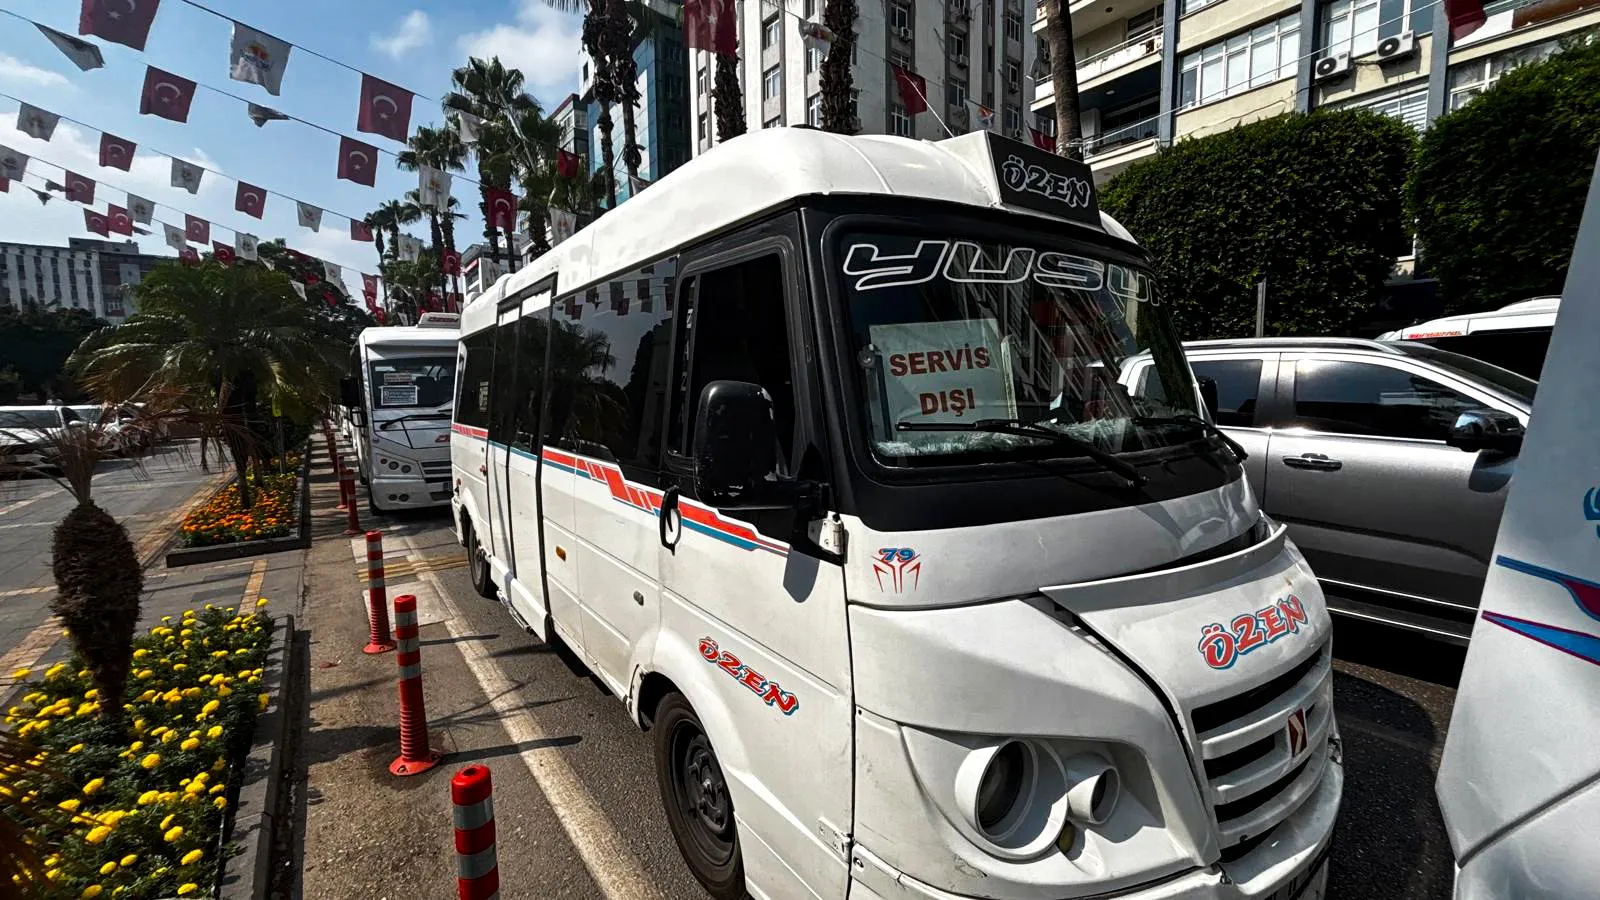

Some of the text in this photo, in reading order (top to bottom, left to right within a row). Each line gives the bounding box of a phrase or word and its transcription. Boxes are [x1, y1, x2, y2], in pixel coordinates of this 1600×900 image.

[1002, 154, 1091, 208] ÖZEN
[889, 343, 991, 377] SERVİS
[919, 387, 975, 417] DIŞI
[879, 547, 915, 563] 79
[1198, 594, 1309, 669] ÖZEN
[699, 636, 800, 716] ÖZEN
